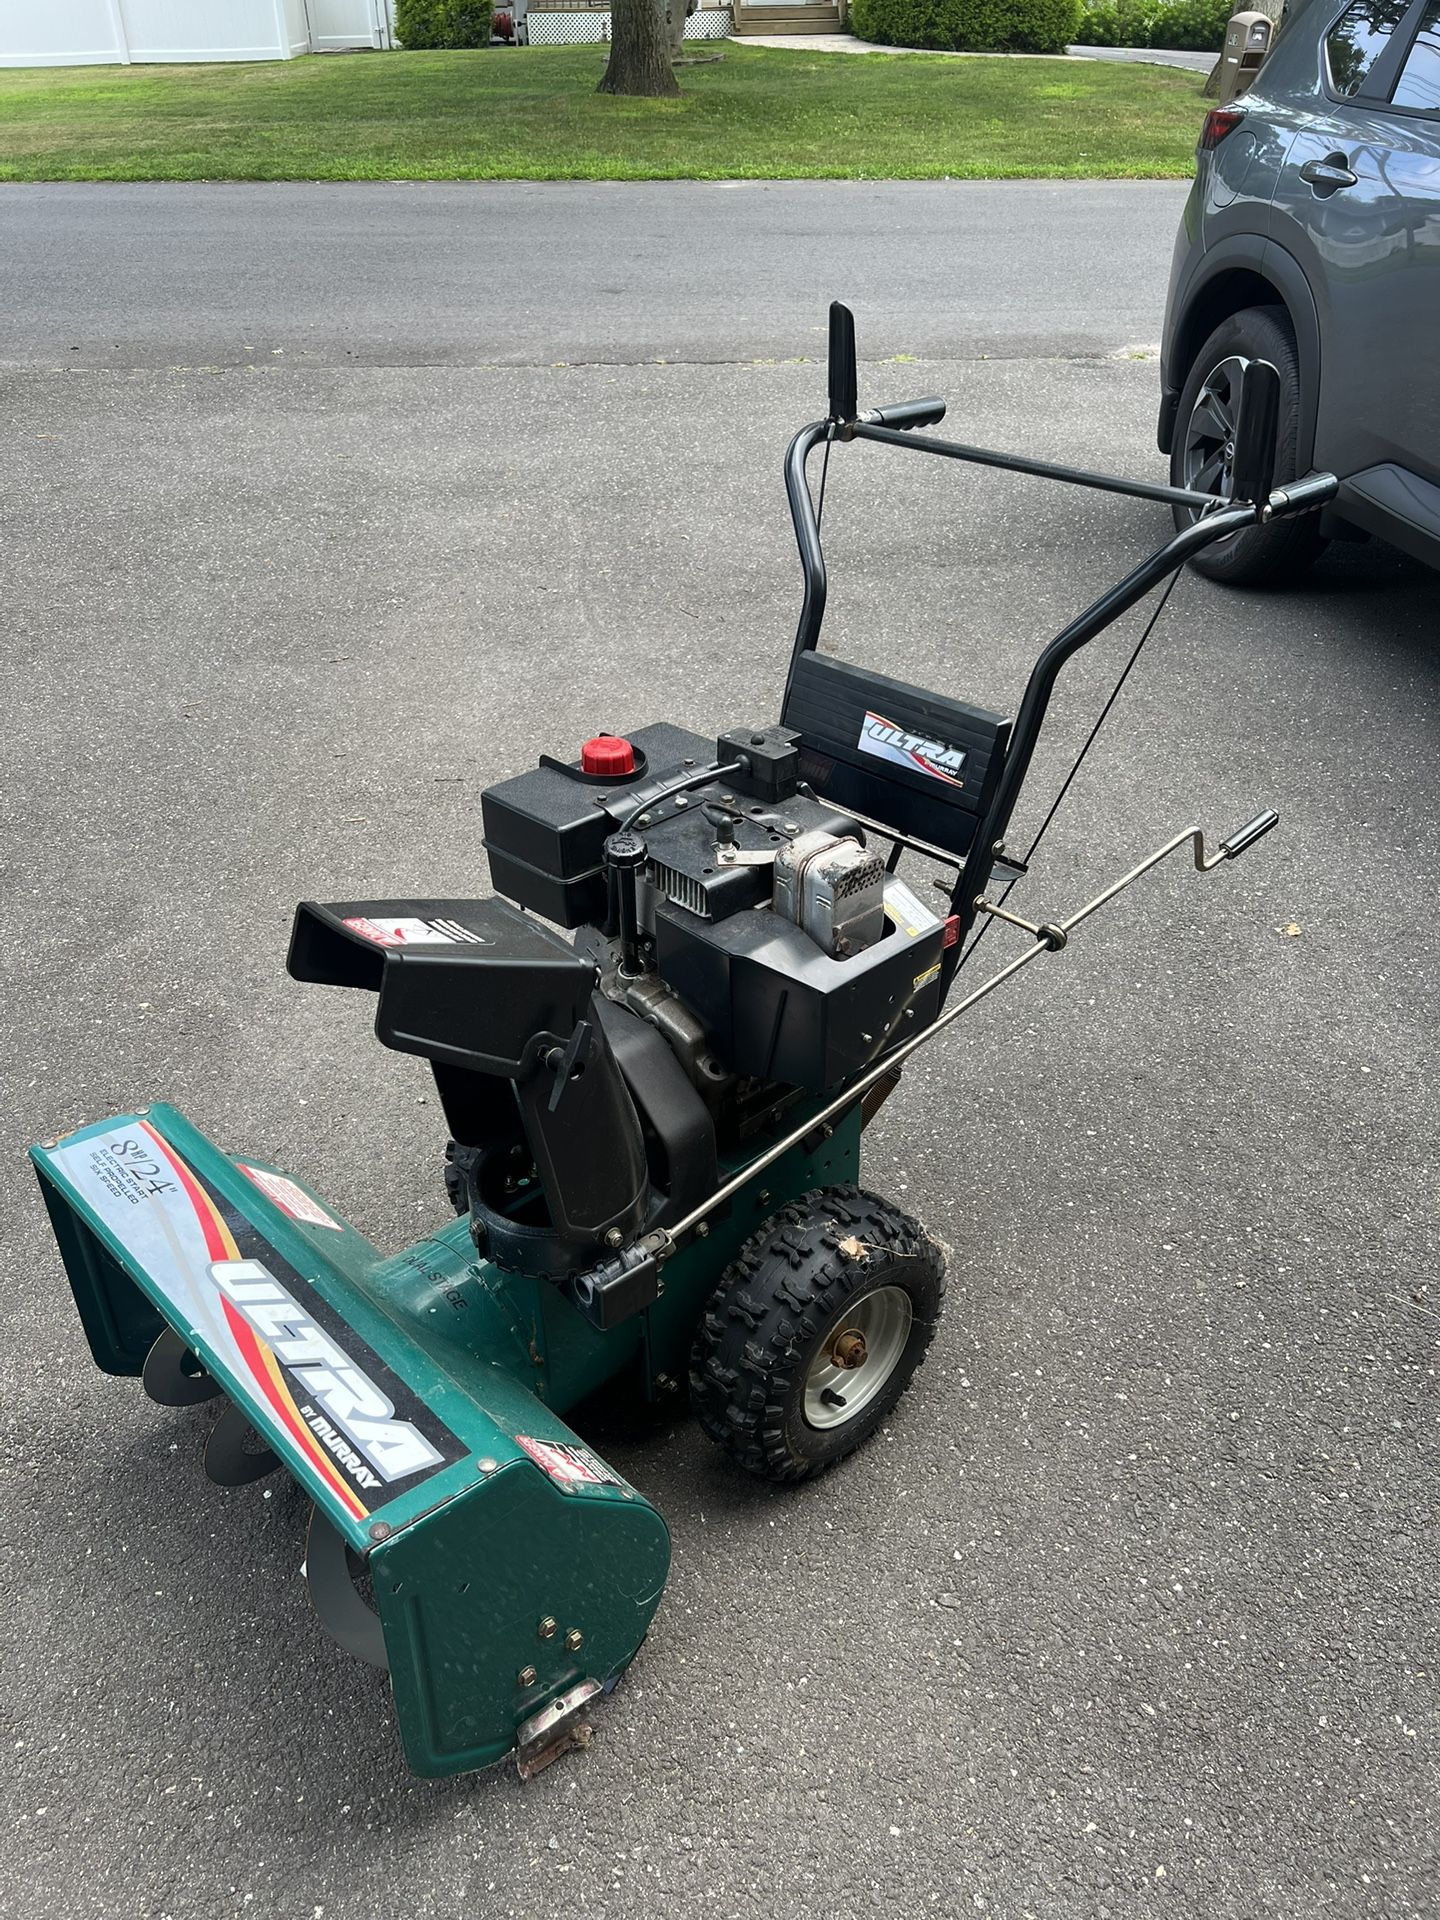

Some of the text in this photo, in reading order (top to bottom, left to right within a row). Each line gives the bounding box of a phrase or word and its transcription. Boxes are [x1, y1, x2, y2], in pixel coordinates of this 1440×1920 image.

[868, 722, 966, 769] ULTRA
[90, 1152, 139, 1204] SELF PROPELLED
[90, 1164, 122, 1197] SIX SPEED
[100, 1149, 149, 1199] ELECTRIC START
[428, 1272, 468, 1311] STAGE
[207, 1260, 442, 1480] ULTRA
[300, 1405, 383, 1489] BY MURRAY
